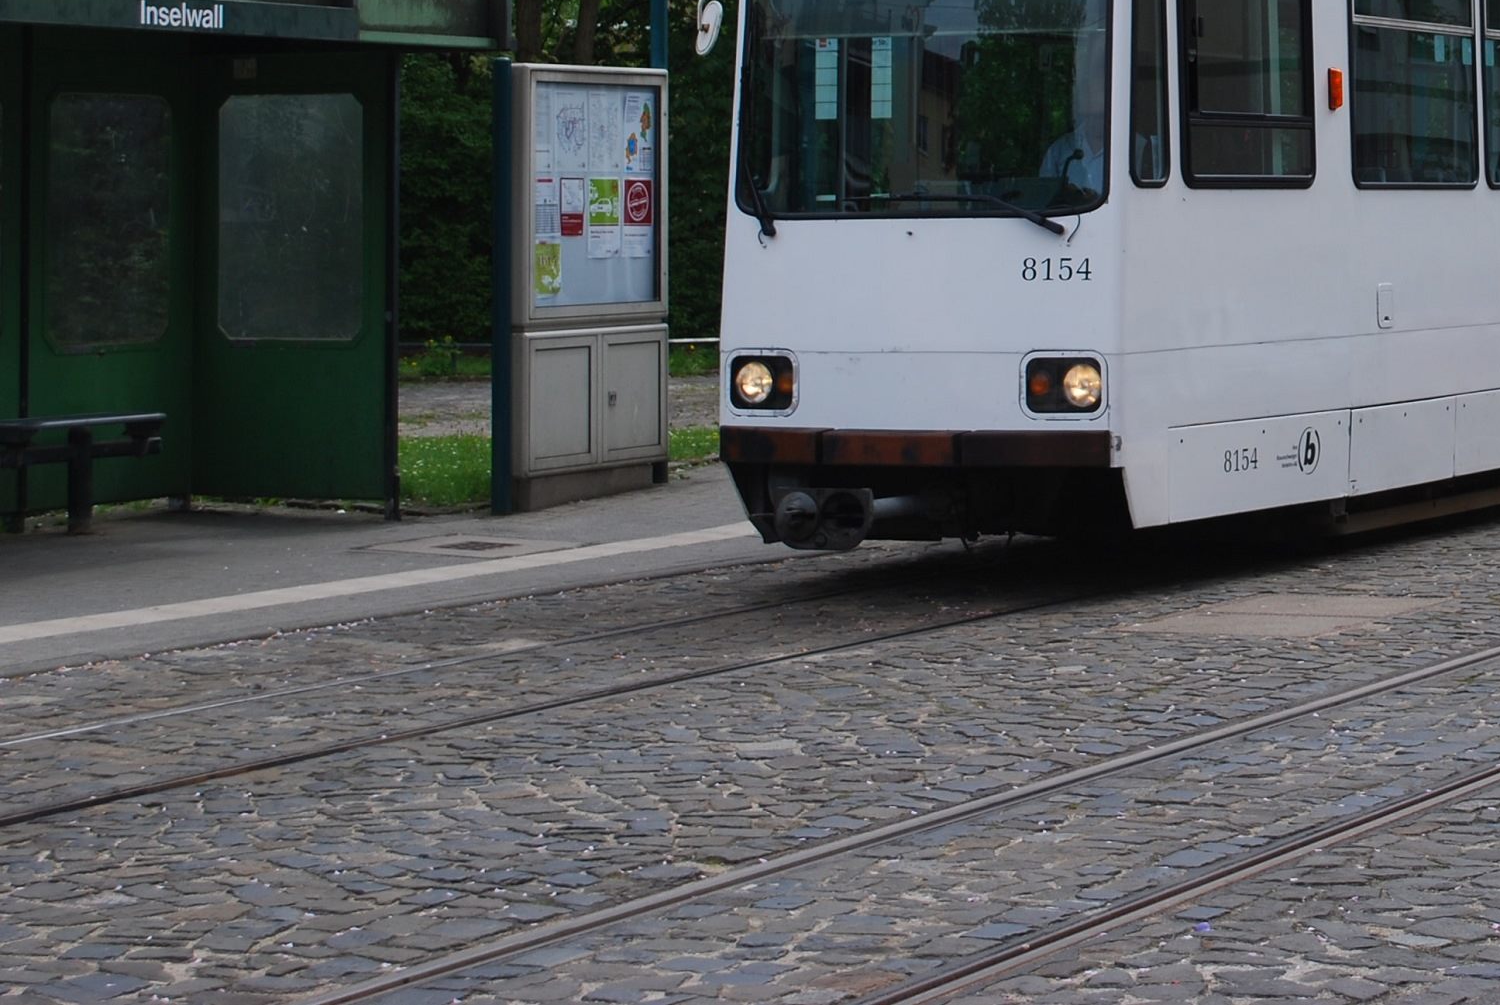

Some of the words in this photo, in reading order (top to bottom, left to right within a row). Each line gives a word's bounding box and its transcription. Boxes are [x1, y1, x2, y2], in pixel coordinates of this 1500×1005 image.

[140, 0, 224, 29] Inselwall
[1022, 257, 1093, 281] 8154
[1223, 447, 1259, 473] 8154
